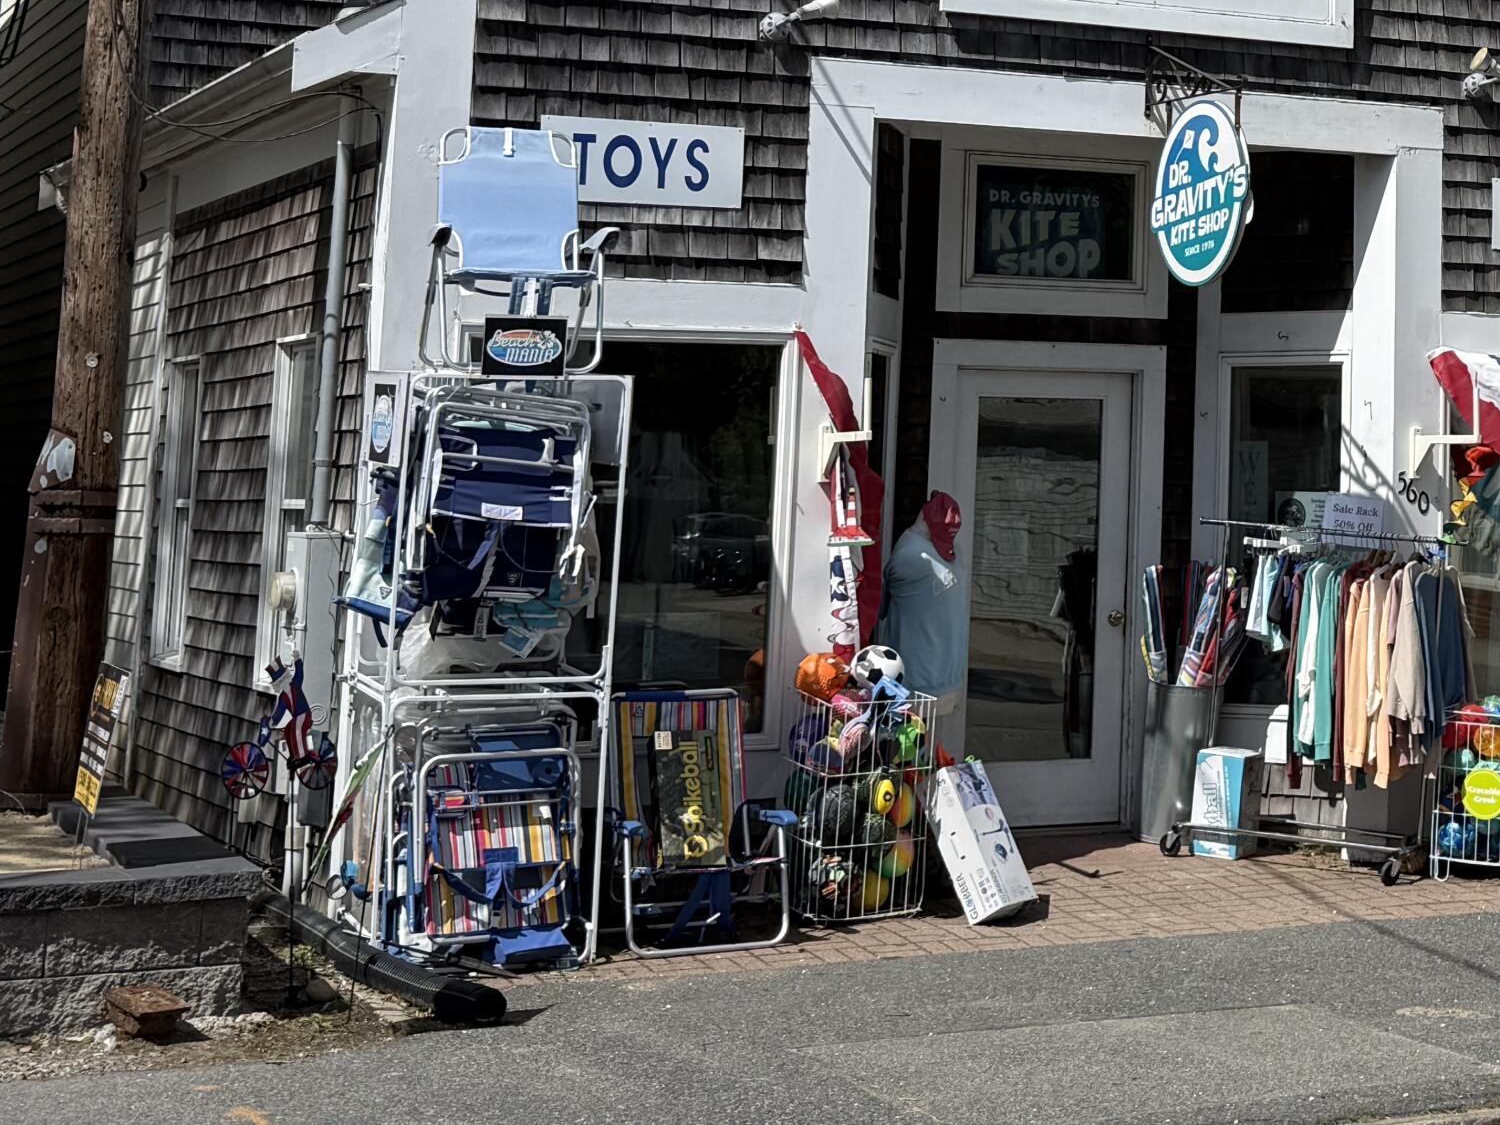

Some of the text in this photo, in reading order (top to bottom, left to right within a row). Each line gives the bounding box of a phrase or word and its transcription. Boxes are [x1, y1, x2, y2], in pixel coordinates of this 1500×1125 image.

[573, 133, 709, 192] TOYS
[1169, 160, 1192, 189] DR.
[989, 189, 1015, 203] DR.
[1152, 165, 1247, 228] GRAVITY'S
[991, 208, 1080, 251] KITE
[1170, 208, 1229, 246] KITE SHOP
[995, 238, 1101, 278] SHOP
[505, 347, 554, 363] MANIA
[1333, 503, 1353, 515] Sale
[1356, 506, 1379, 518] Rack
[1398, 470, 1430, 516] 560
[1334, 519, 1355, 530] 50%
